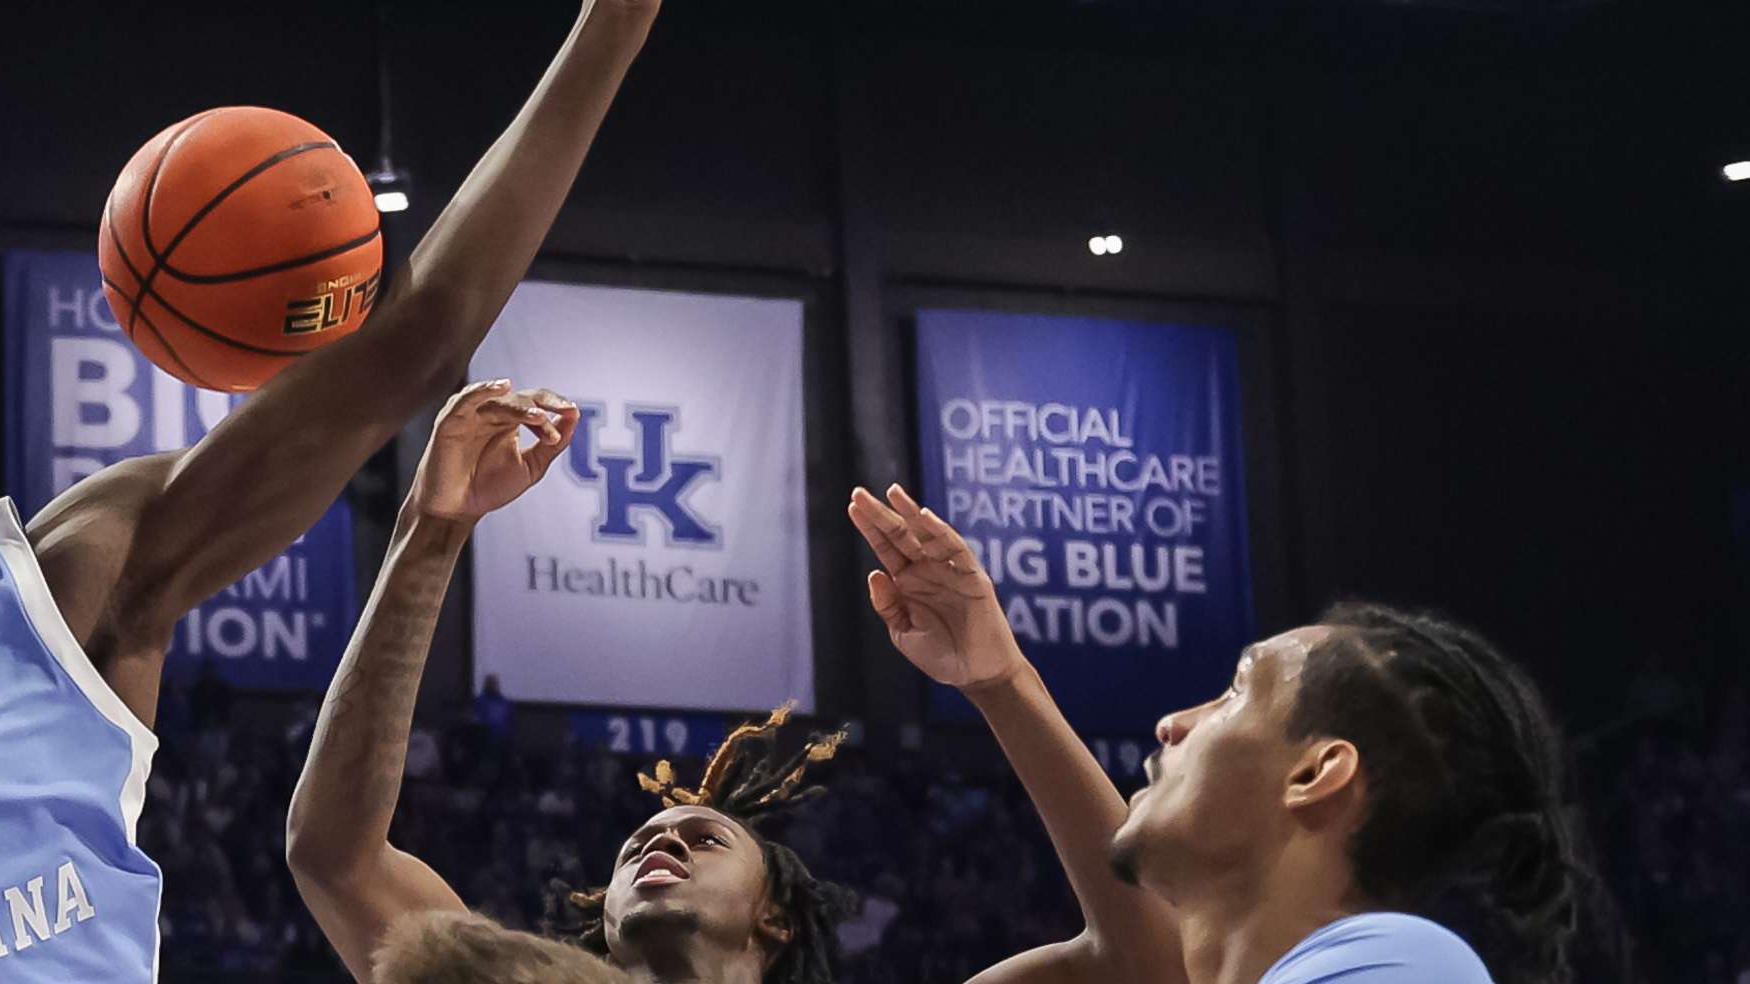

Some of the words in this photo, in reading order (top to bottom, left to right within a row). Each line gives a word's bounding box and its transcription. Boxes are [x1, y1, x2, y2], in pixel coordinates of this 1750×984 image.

[52, 337, 232, 452] BI
[942, 398, 1133, 448] OFFICIAL
[561, 402, 722, 548] UK
[944, 443, 1221, 496] HEALTHCARE
[948, 488, 1136, 533] PARTNER
[1146, 497, 1207, 537] OF
[527, 556, 761, 606] HealthCare
[1064, 540, 1207, 593] BLUE
[606, 716, 690, 753] 219
